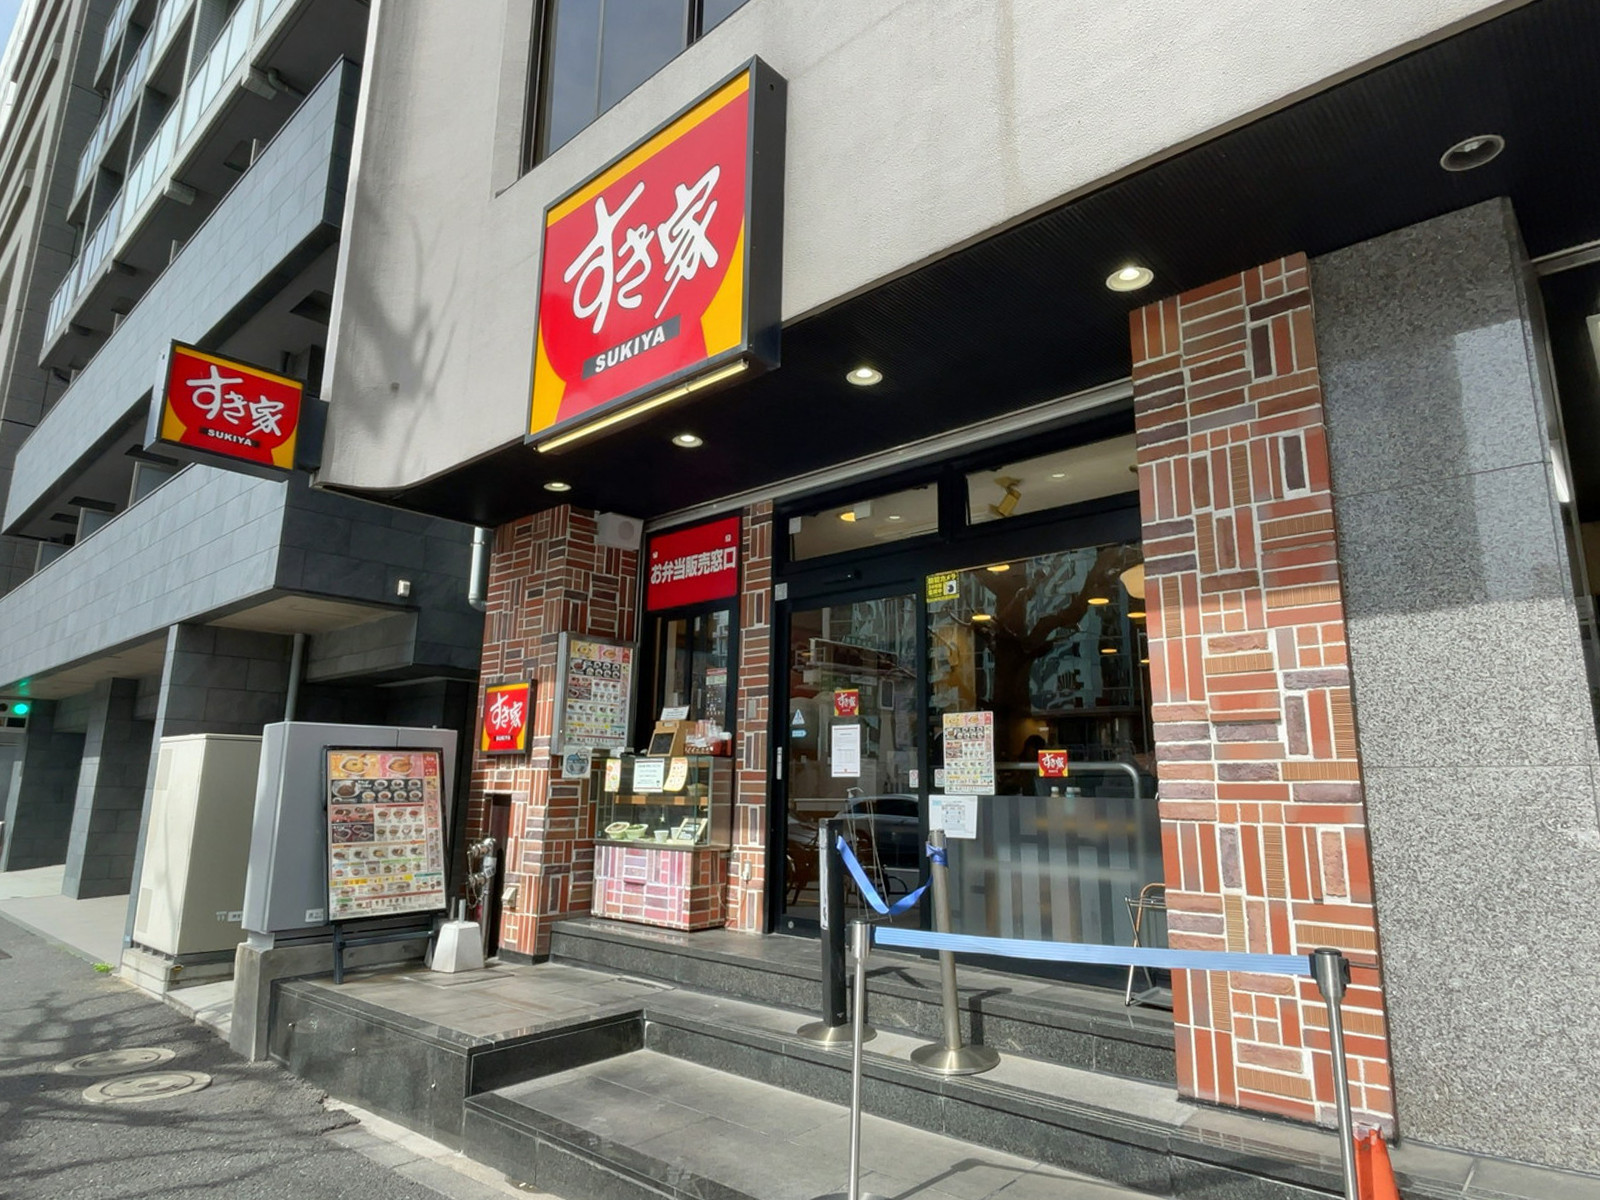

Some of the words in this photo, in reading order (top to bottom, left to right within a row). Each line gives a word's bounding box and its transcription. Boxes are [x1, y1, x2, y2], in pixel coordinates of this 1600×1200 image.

[563, 164, 721, 335] すき家
[594, 324, 666, 374] SUKIYA
[185, 364, 285, 437] すき家
[207, 428, 252, 447] SUKIYA
[650, 546, 737, 585] お弁当販売窓口
[489, 692, 523, 734] すき家
